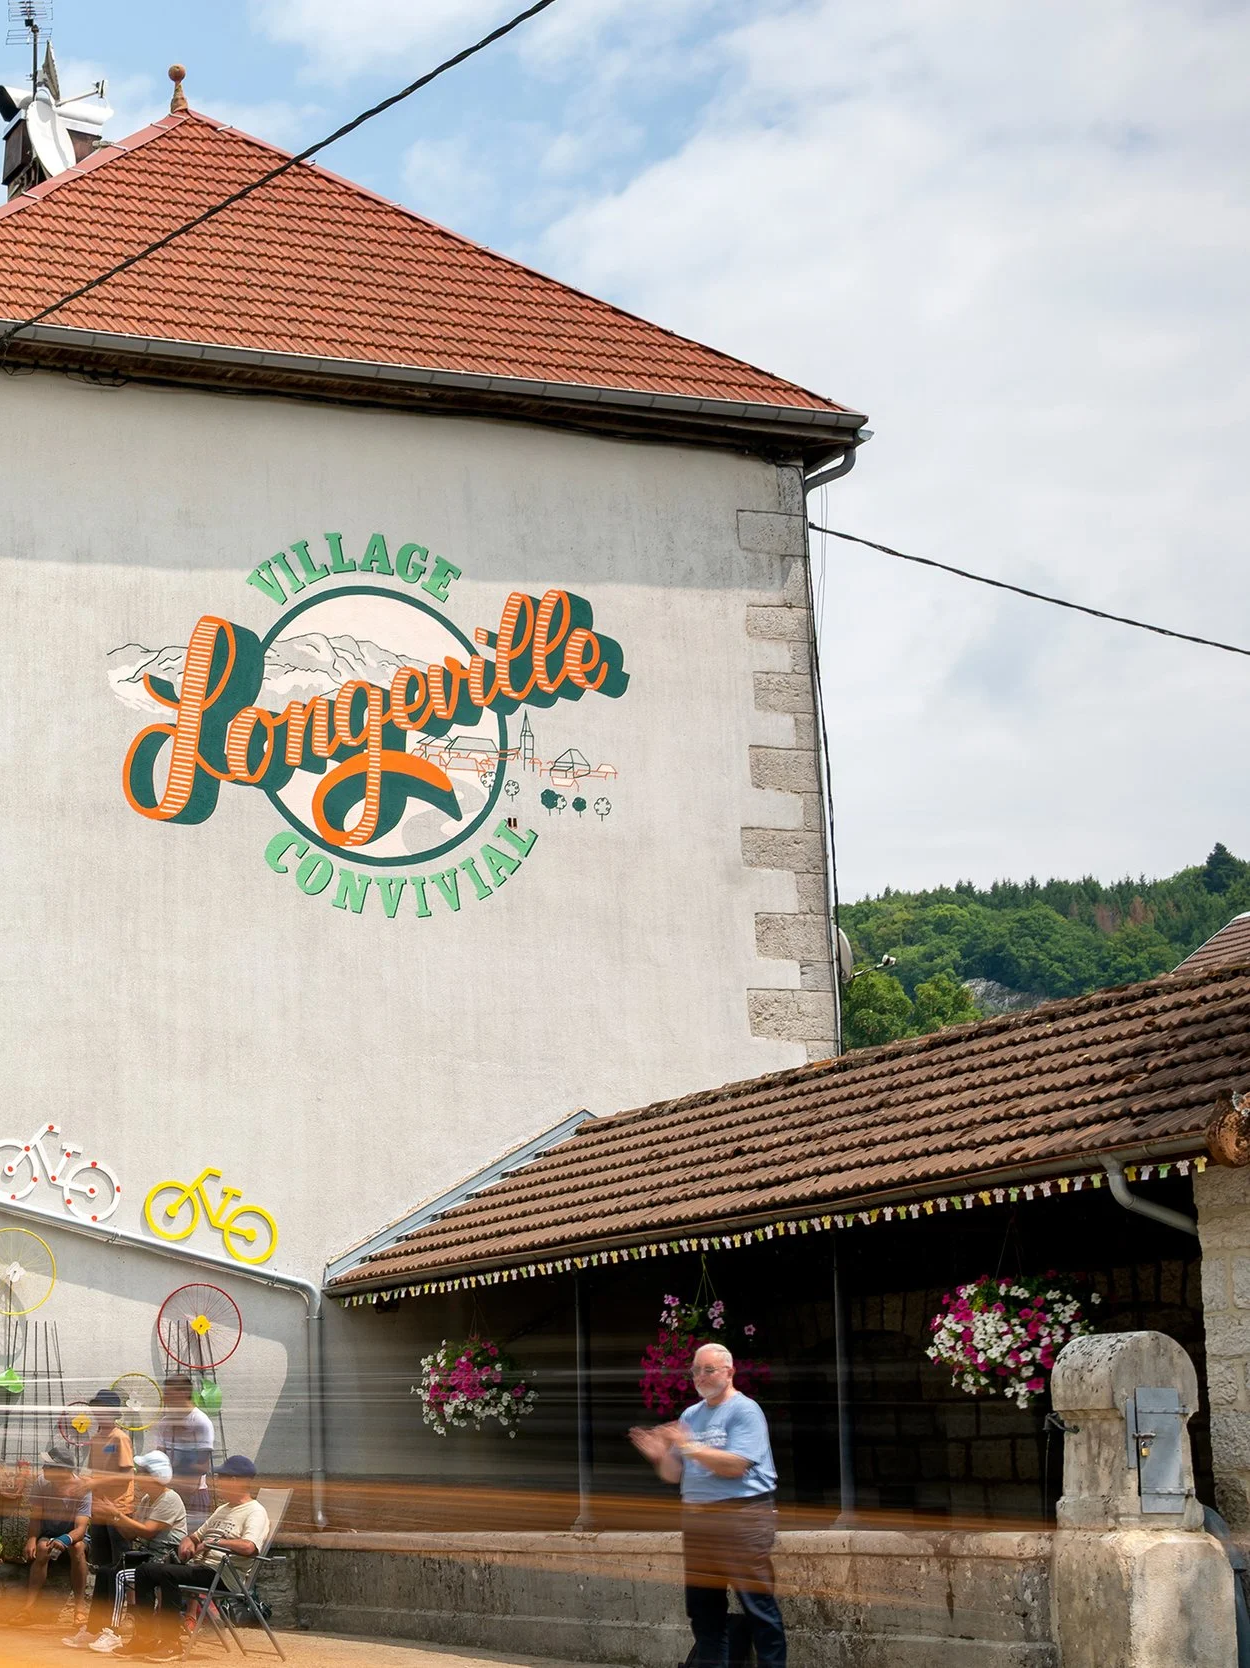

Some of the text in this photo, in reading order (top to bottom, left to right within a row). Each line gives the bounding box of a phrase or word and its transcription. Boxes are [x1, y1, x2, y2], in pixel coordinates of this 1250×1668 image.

[246, 532, 462, 605] VILLAGE
[123, 589, 630, 846] Longeville
[264, 819, 538, 918] CONVIVIAL
